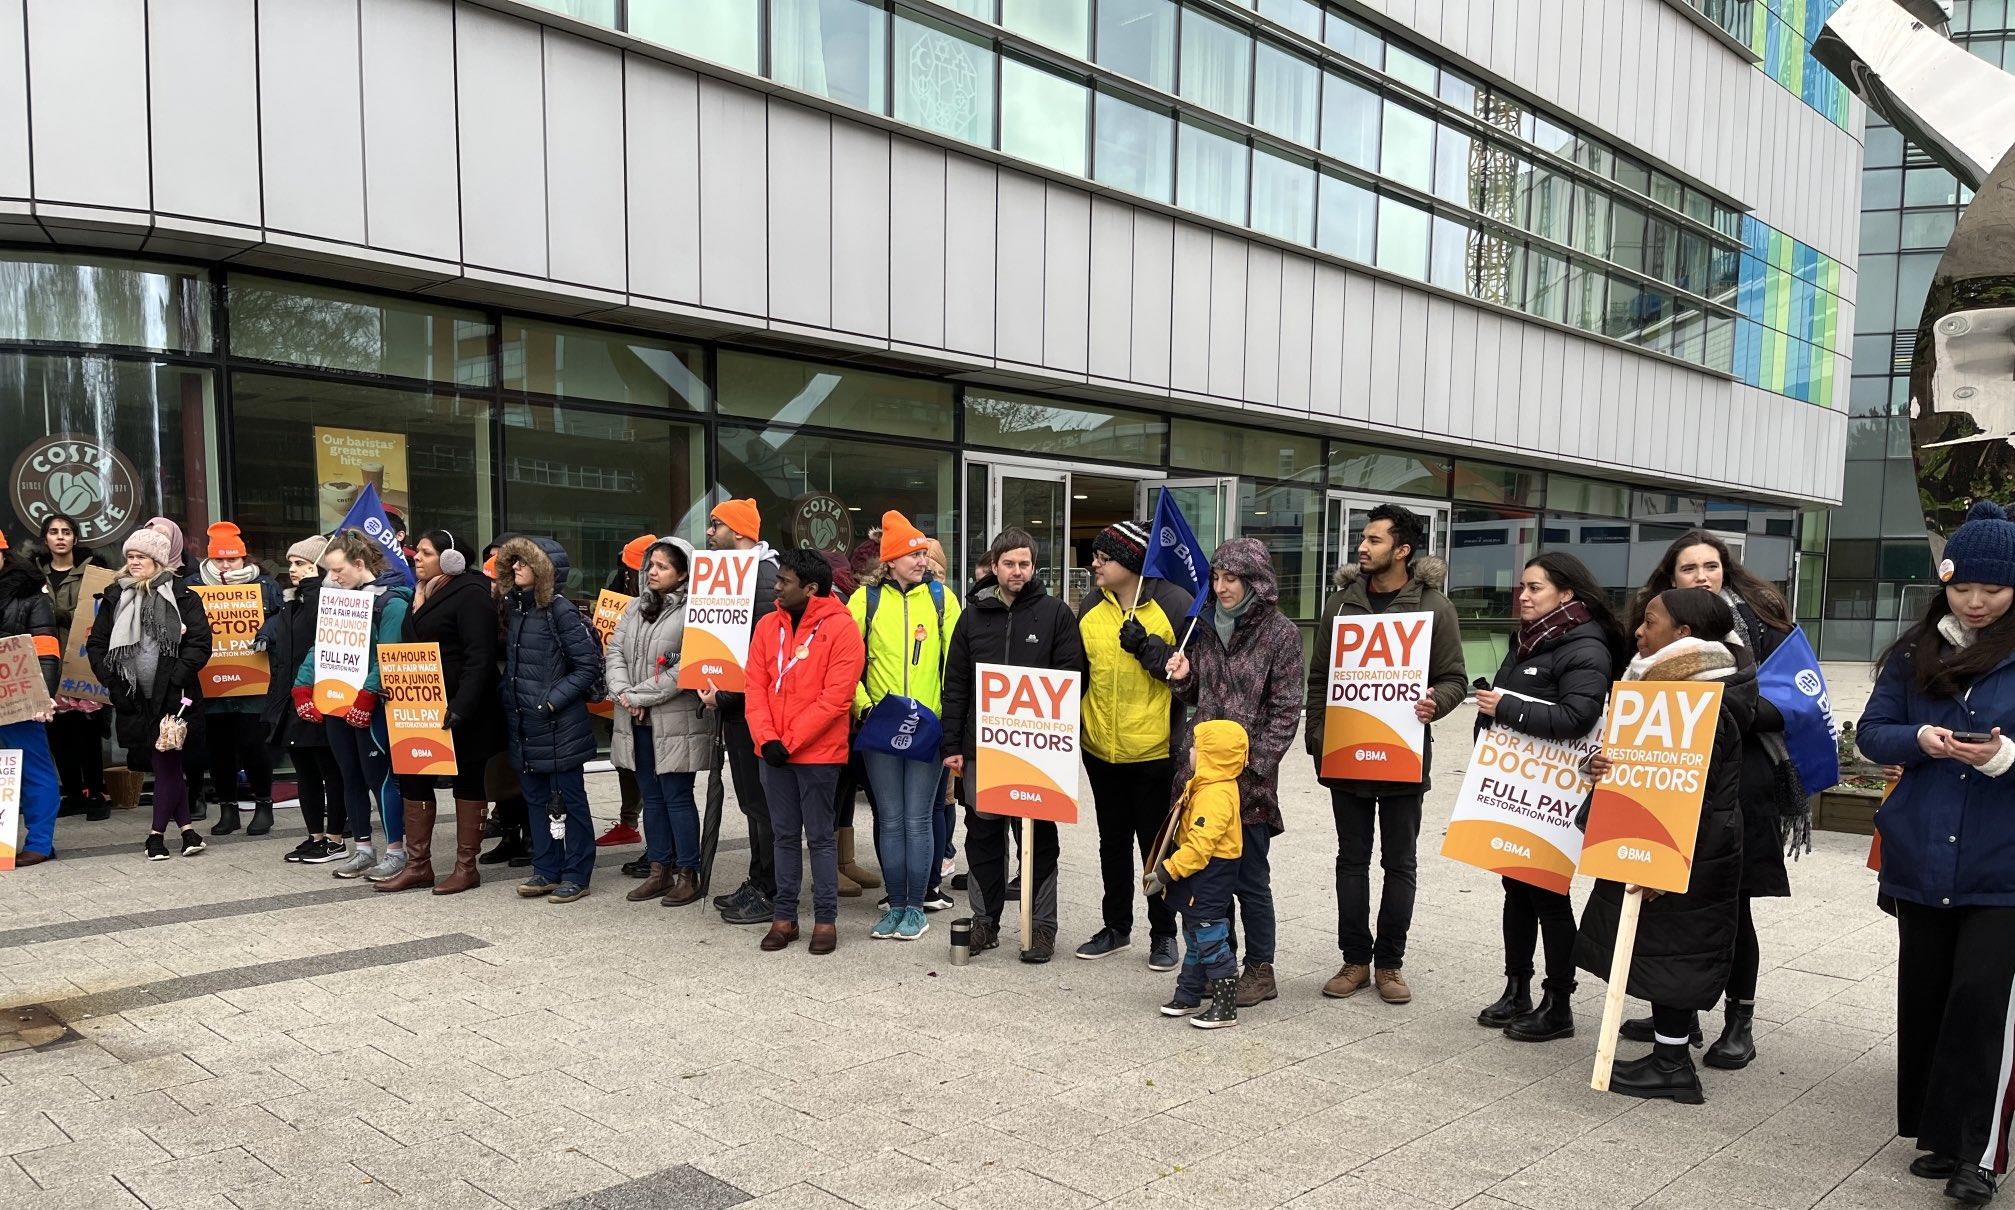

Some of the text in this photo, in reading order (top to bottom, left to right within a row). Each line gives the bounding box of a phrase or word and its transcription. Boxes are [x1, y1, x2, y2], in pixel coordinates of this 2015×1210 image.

[322, 434, 396, 449] Our baristas'
[330, 446, 380, 457] greatest
[33, 444, 112, 474] COSTA
[804, 499, 841, 520] COSTA
[29, 502, 125, 537] CFEE
[692, 556, 755, 595] PAY
[201, 591, 256, 601] /HOUR IS
[322, 596, 369, 609] £14/HOUR IS
[690, 598, 750, 606] RESTORATION FOR
[209, 602, 230, 610] FAIR
[232, 601, 258, 609] WAGE
[602, 598, 627, 611] £14/
[218, 610, 258, 621] JUNIOR
[338, 609, 350, 617] FAIR
[352, 610, 368, 619] WAGE
[599, 608, 615, 618] NOT
[688, 608, 748, 624] DOCTORS
[210, 620, 260, 634] CTOR
[320, 617, 368, 630] FOR A JUNIOR
[596, 618, 616, 631] FOR
[319, 628, 366, 648] DOCTOR
[1335, 620, 1426, 668] PAY
[321, 650, 360, 666] FULL PAY
[382, 651, 436, 662] £14/HOUR IS
[418, 664, 437, 672] WAGE
[708, 665, 723, 674] BMA
[384, 674, 440, 685] FOR A JUNIOR
[1334, 670, 1422, 681] RESTORATION FOR
[386, 686, 442, 702] DOCTOR
[982, 671, 1074, 720] PAY
[1332, 683, 1421, 702] DOCTORS
[393, 709, 439, 721] FULL PAY
[1608, 690, 1715, 749] PAY
[982, 716, 1074, 733] RESTORATION FOR
[982, 726, 1073, 752] DOCTORS
[1365, 750, 1387, 761] BMA
[1485, 730, 1521, 750] FOR
[1522, 741, 1535, 755] A
[1537, 747, 1581, 767] JUNI
[1606, 747, 1703, 766] RESTORATION FOR
[1602, 764, 1700, 794] DOCTORS
[1021, 792, 1042, 802] BMA
[1480, 778, 1578, 819] FULL PAY
[1477, 794, 1572, 829] RESTORATION NOW
[1504, 842, 1531, 859] BMA
[1629, 849, 1652, 863] BMA
